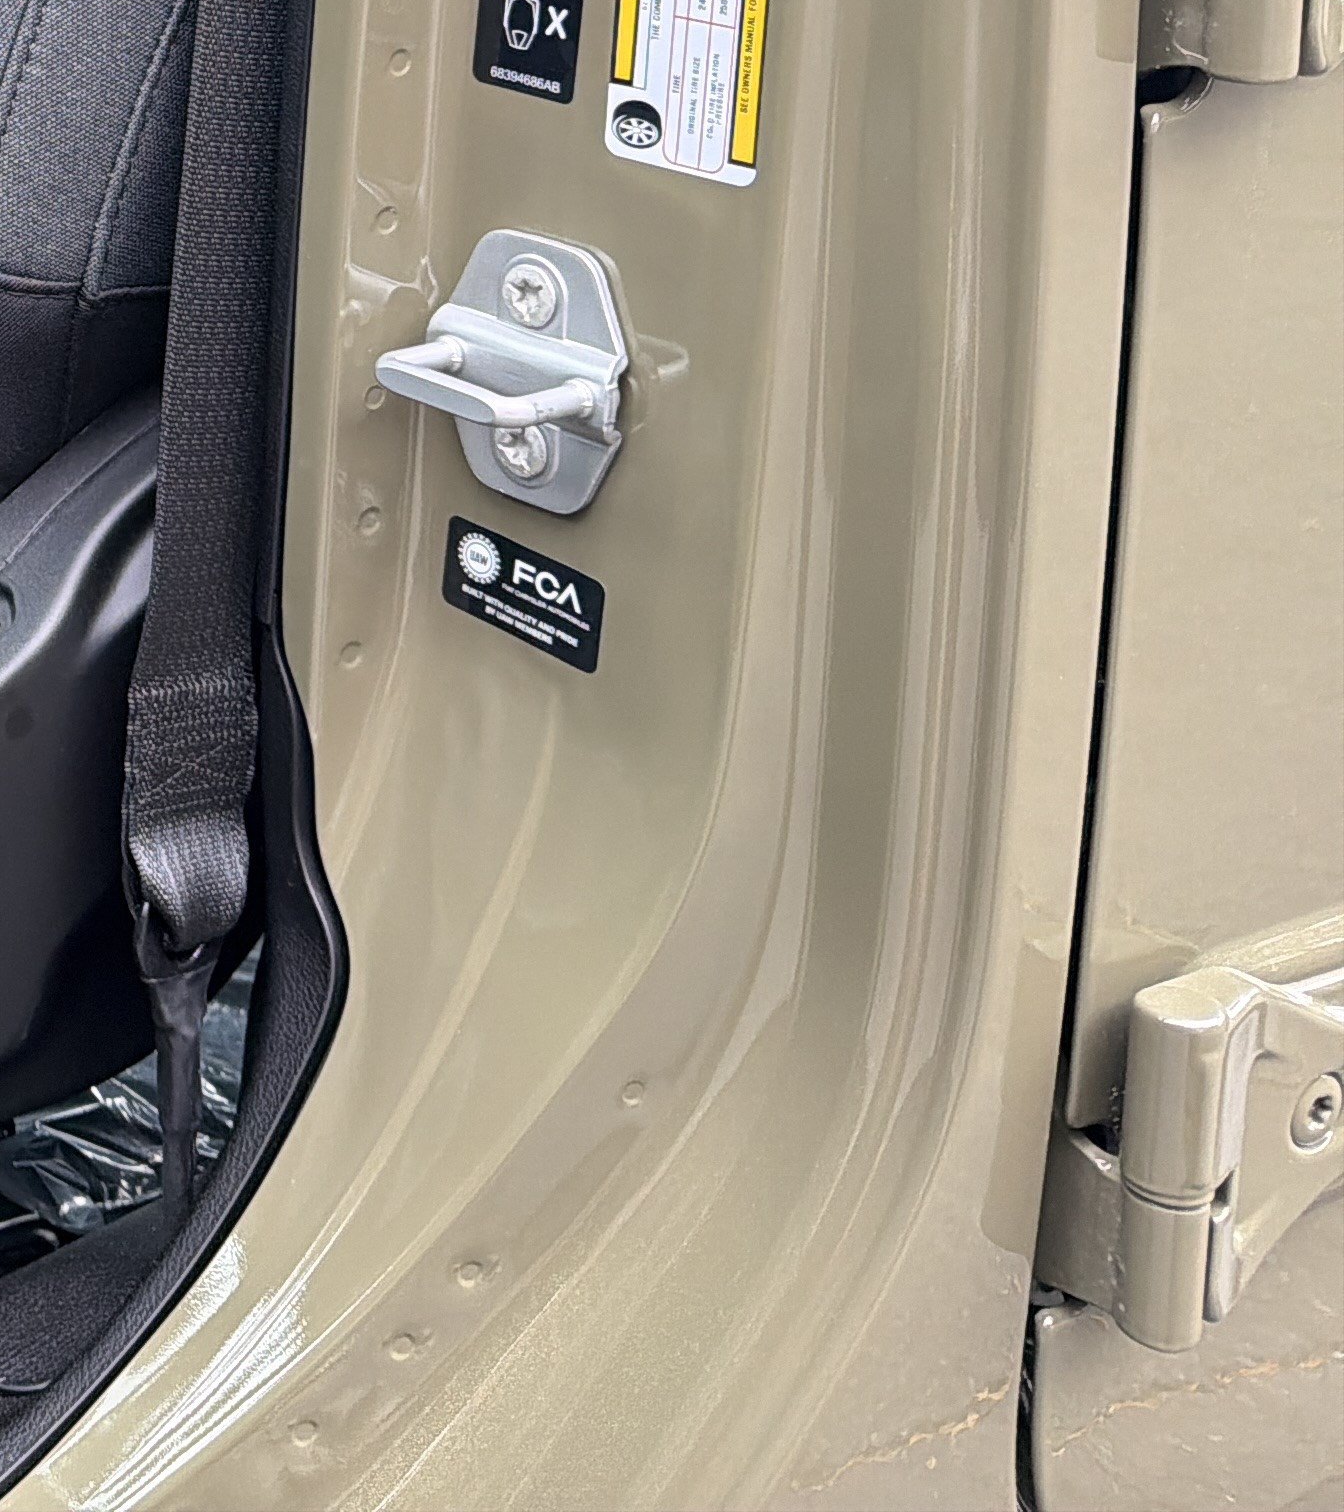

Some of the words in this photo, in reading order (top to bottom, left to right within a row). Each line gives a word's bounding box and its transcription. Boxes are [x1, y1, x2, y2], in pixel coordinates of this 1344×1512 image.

[744, 15, 755, 53] MANUAL
[490, 64, 560, 94] 68394686AB
[741, 55, 752, 94] OWNERS
[739, 96, 749, 113] SEE
[512, 557, 583, 615] FCA
